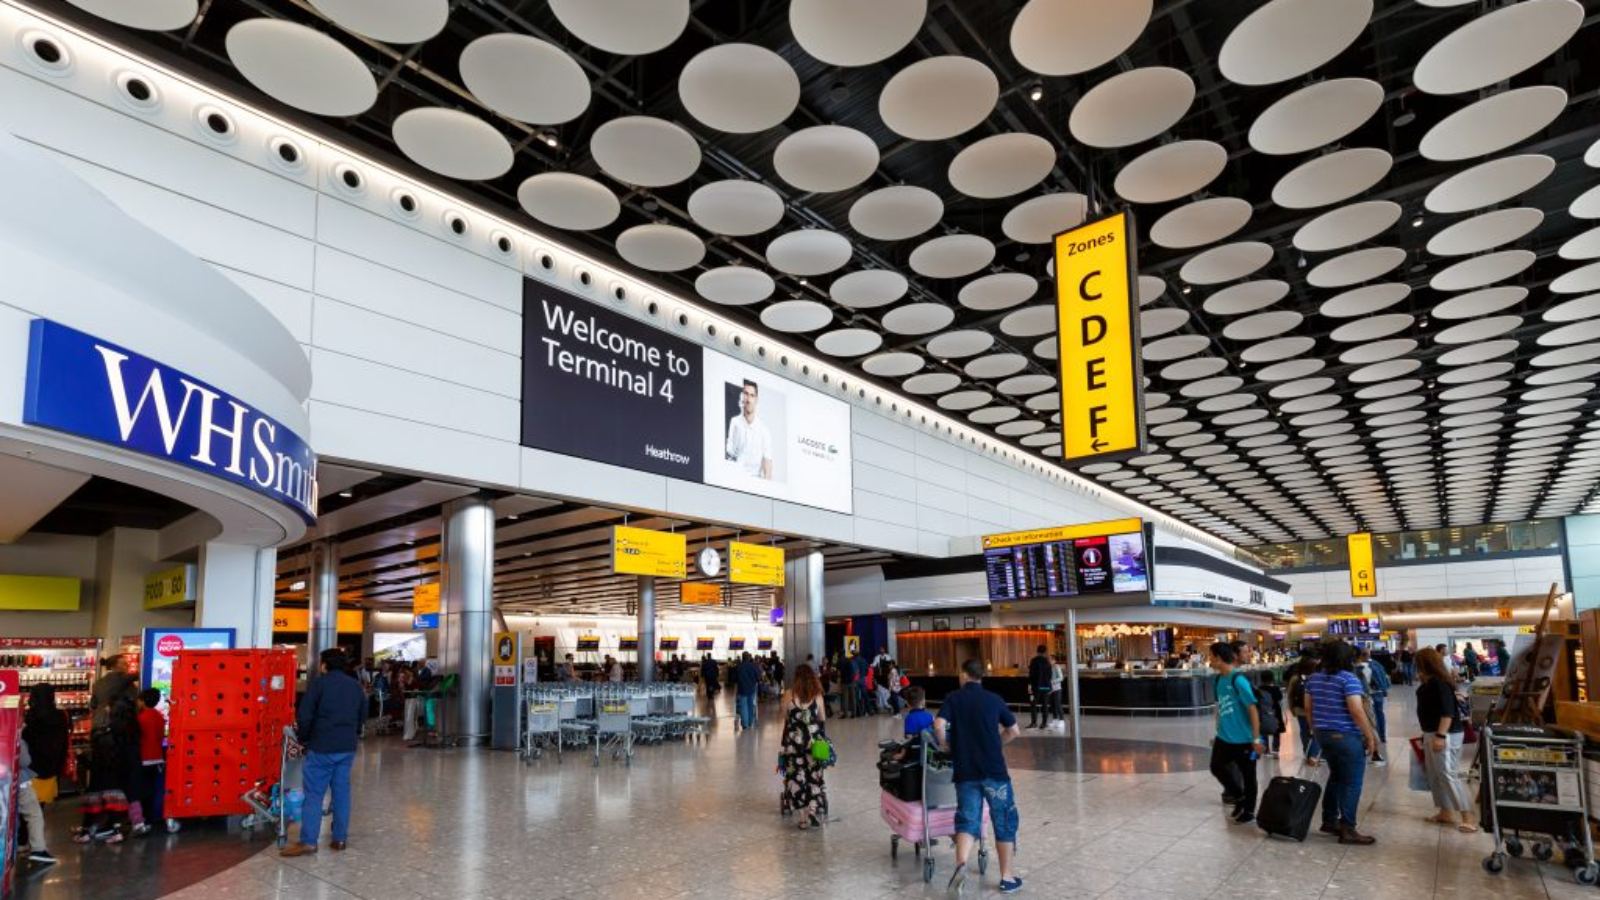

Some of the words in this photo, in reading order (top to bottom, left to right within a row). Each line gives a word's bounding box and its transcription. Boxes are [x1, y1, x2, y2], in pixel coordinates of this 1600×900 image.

[1068, 232, 1115, 257] Zones
[1079, 270, 1102, 301] C
[542, 300, 661, 367] Welcome
[666, 349, 690, 376] to
[1081, 315, 1108, 346] D
[541, 336, 653, 398] Terminal
[659, 379, 674, 403] 4
[1086, 357, 1107, 391] E
[1089, 405, 1108, 438] F
[645, 443, 690, 465] Heathrow
[1358, 569, 1368, 579] G
[1359, 581, 1368, 592] H
